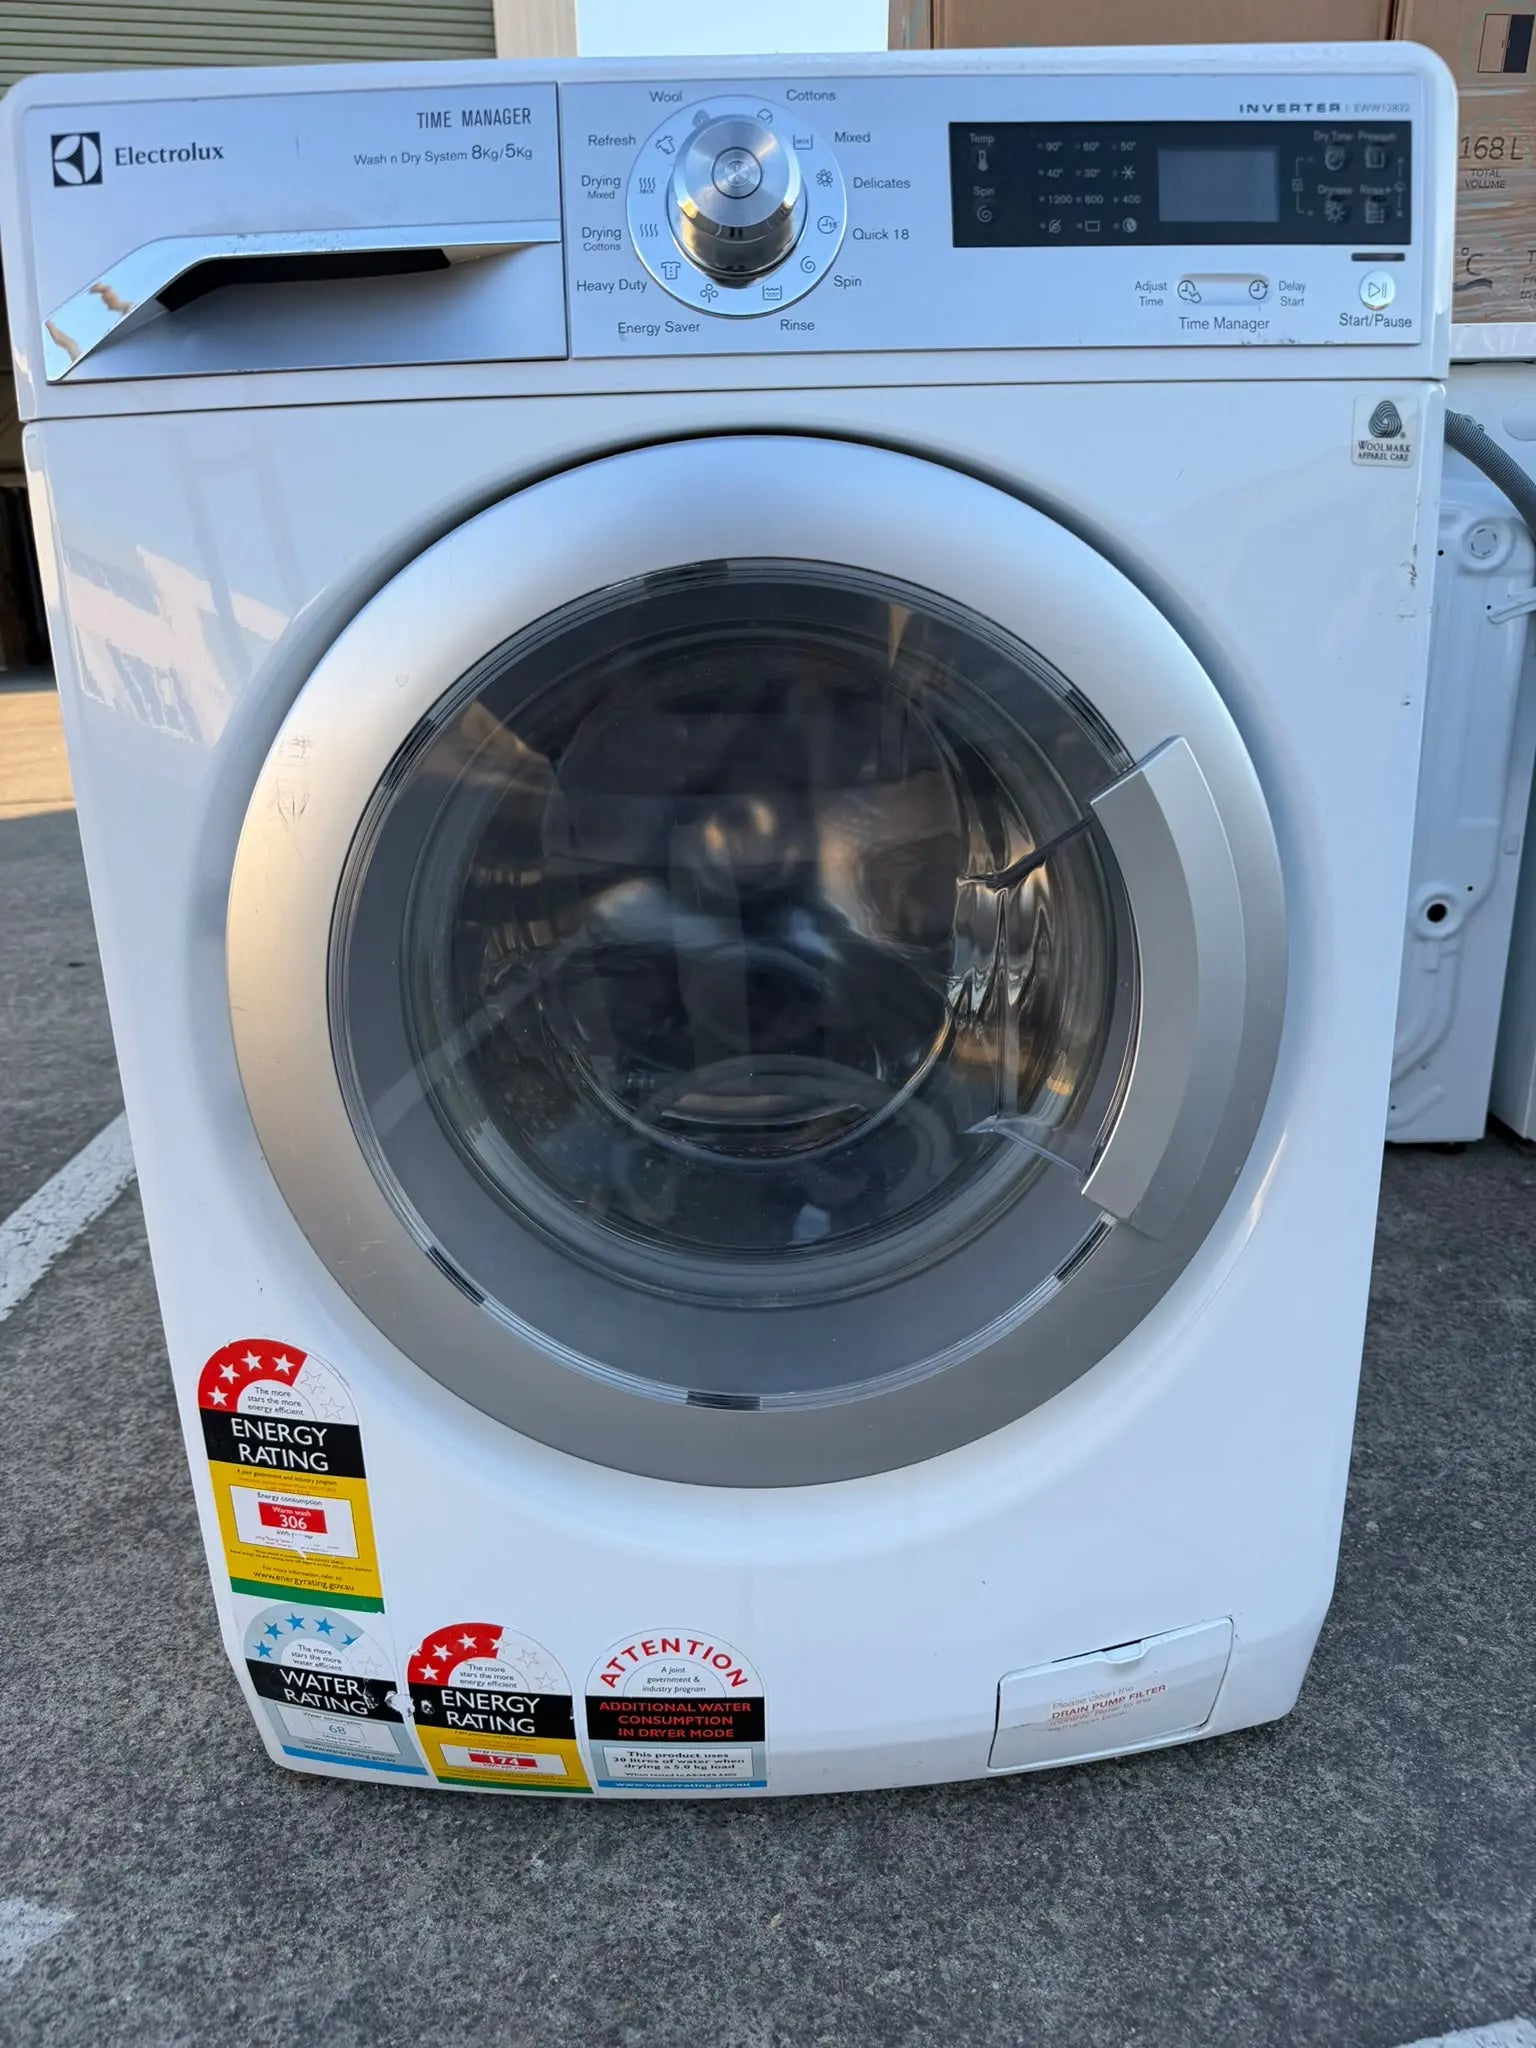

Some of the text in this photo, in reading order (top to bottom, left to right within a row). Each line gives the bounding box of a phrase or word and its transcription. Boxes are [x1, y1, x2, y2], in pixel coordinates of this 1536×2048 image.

[650, 90, 683, 102] Wool
[786, 88, 836, 102] Cottons
[1239, 102, 1341, 114] INVERTER
[416, 108, 532, 130] TIME MANAGER
[588, 133, 637, 147] Refresh
[834, 131, 871, 144] Mixed
[970, 132, 995, 147] Temp
[114, 142, 225, 168] Electrolux
[354, 143, 533, 167] Wash n Dry System 8Kg/5Kg
[1459, 136, 1524, 160] 168 L
[1470, 168, 1502, 178] TOTAL
[581, 175, 622, 190] Drying
[853, 176, 911, 190] Delicates
[1465, 180, 1507, 189] VOLUME
[587, 189, 616, 200] Mixed
[973, 185, 995, 198] Spin
[581, 227, 622, 241] Drying
[853, 228, 910, 241] Quick 18
[583, 241, 622, 252] Cottons
[576, 278, 648, 294] Heavy Duty
[833, 275, 863, 290] Spin
[1134, 280, 1168, 295] Adjust
[1278, 280, 1307, 295] Delay
[1139, 296, 1164, 308] Time
[1280, 296, 1305, 307] Start
[780, 319, 816, 332] Rinse
[1179, 316, 1271, 334] Time Manager
[1339, 311, 1413, 330] Start/Pause
[618, 319, 701, 337] Energy Saver
[1358, 440, 1411, 453] WOOLMARK
[1358, 452, 1409, 462] APPAREL CARE
[254, 1386, 292, 1398] The more
[247, 1394, 302, 1408] stars the more
[247, 1403, 304, 1417] energy efficient
[230, 1417, 328, 1447] ENERGY
[238, 1443, 329, 1473] RATING
[257, 1491, 323, 1507] Energy consumption
[271, 1506, 294, 1515] Warm
[279, 1514, 308, 1531] 306
[253, 1571, 355, 1592] www.energyrating.gov.au
[297, 1644, 333, 1656] The more
[290, 1652, 343, 1666] stars the more
[292, 1658, 343, 1672] water efficient
[599, 1637, 749, 1689] ATTENTION
[466, 1663, 505, 1674] The more
[660, 1666, 686, 1675] A joint
[279, 1668, 362, 1698] WATER
[459, 1671, 515, 1682] stars the more
[646, 1675, 691, 1685] government
[459, 1678, 518, 1690] energy efficient
[642, 1684, 706, 1694] industry program
[1088, 1690, 1117, 1702] clean
[1118, 1685, 1135, 1695] the
[284, 1687, 368, 1716] RATING
[441, 1689, 541, 1714] ENERGY
[600, 1701, 752, 1713] ADDITIONAL WATER
[1051, 1704, 1089, 1720] DRAIN
[1091, 1696, 1126, 1711] PUMP
[1129, 1684, 1167, 1701] FILTER
[446, 1711, 536, 1735] RATING
[617, 1715, 733, 1726] CONSUMPTION
[328, 1724, 347, 1736] 68
[618, 1727, 735, 1739] IN DRYER MODE
[488, 1756, 520, 1766] 174
[655, 1752, 701, 1760] product
[624, 1763, 661, 1771] drying
